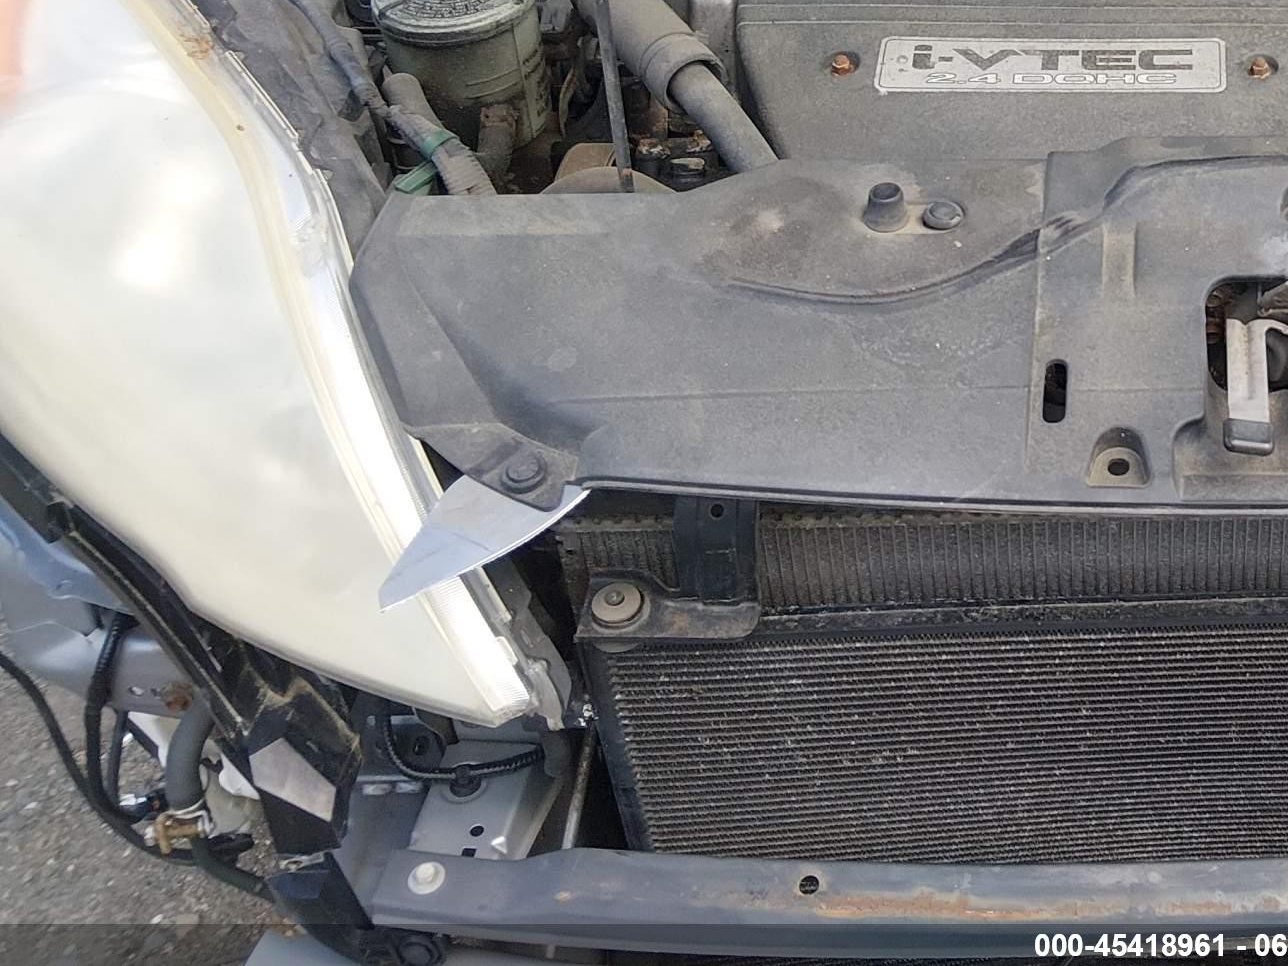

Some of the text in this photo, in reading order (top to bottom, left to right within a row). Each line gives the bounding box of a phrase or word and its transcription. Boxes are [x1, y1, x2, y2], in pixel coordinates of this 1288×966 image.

[911, 45, 1193, 71] i-VTEC
[926, 72, 1177, 85] 2.4 DOHC
